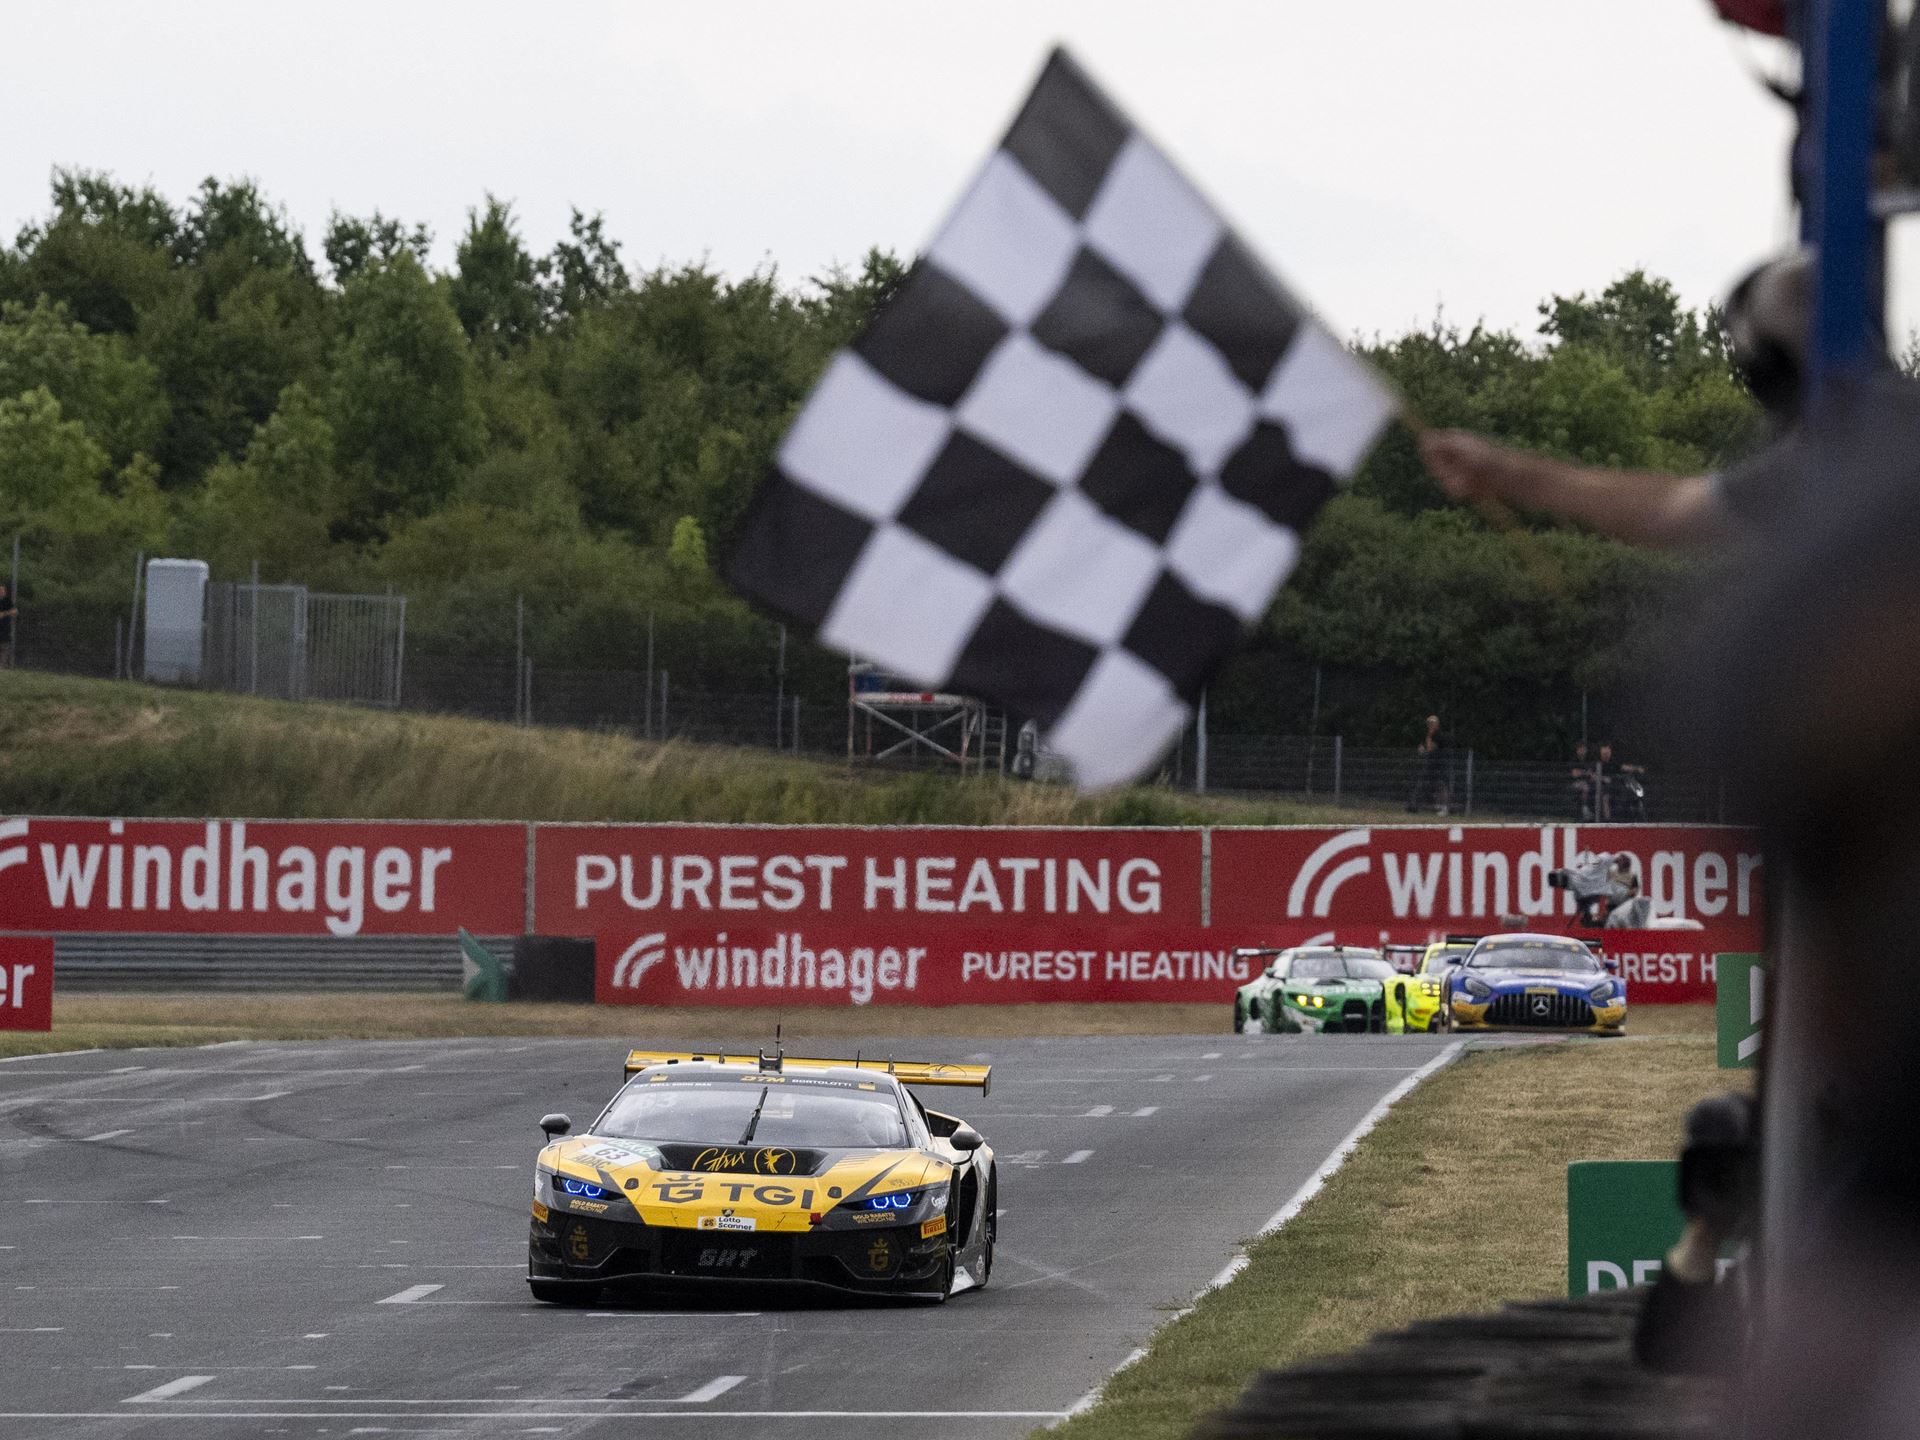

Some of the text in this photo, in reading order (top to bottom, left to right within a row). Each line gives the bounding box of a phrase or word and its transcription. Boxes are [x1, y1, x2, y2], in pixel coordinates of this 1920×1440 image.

[40, 820, 452, 937] windhager
[575, 854, 1161, 913] PUREST HEATING
[674, 931, 1250, 1005] windhager PUREST HEATING
[595, 1148, 629, 1160] 63
[720, 1183, 814, 1210] TGI
[718, 1223, 752, 1231] Scanner
[924, 1219, 945, 1234] PIRELLI
